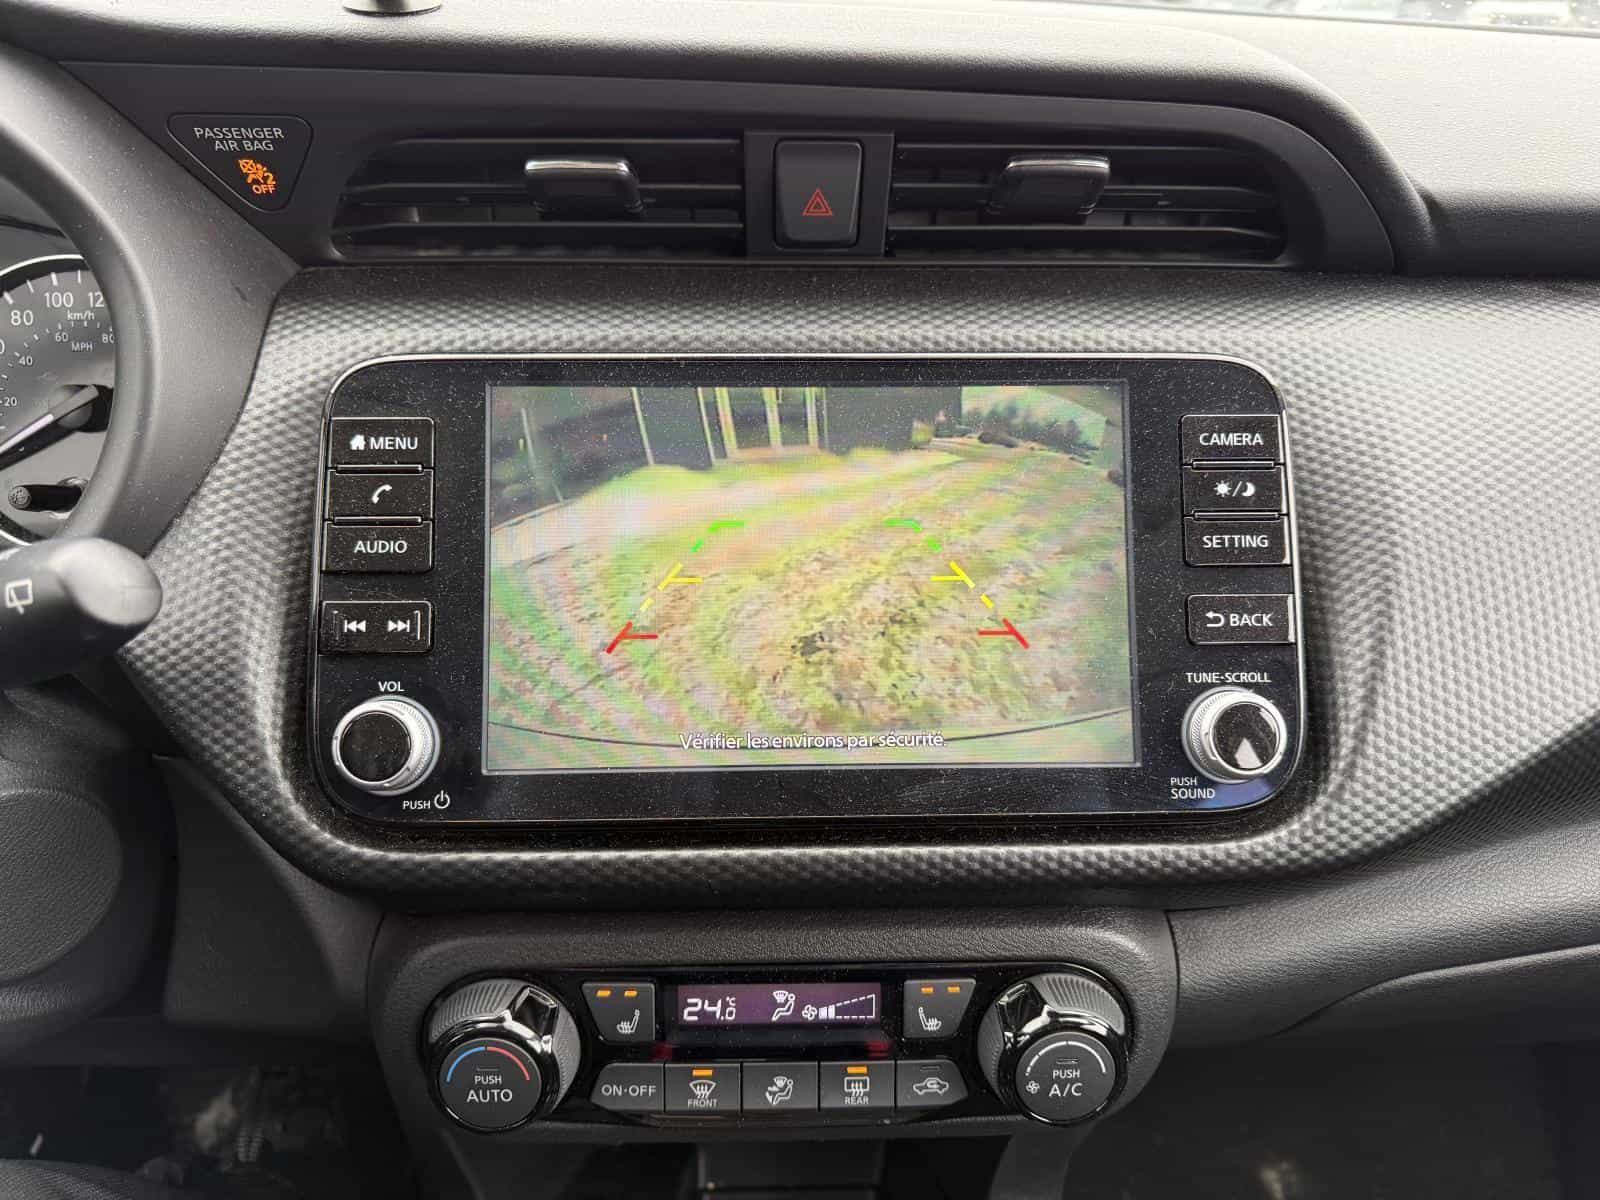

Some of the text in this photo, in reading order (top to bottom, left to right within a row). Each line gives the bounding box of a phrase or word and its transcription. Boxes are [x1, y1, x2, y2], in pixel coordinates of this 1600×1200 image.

[193, 127, 284, 139] PASSENGER
[215, 140, 274, 151] AIR BAG
[252, 184, 276, 194] OFF
[44, 291, 73, 308] 100
[10, 310, 33, 326] 80
[67, 310, 95, 321] km/h
[55, 332, 68, 342] 60
[72, 342, 93, 352] MPH
[19, 356, 33, 366] 40
[4, 396, 17, 407] 20
[369, 436, 418, 450] MENU
[1199, 433, 1264, 446] CAMERA
[354, 540, 408, 554] AUDIO
[1202, 535, 1269, 548] SETTING
[1229, 613, 1273, 627] BACK
[378, 681, 404, 692] VOL
[680, 731, 743, 750] Vérifier
[747, 732, 769, 748] les
[772, 732, 843, 748] environs
[847, 735, 875, 751] par
[1170, 777, 1198, 786] PUSH
[1171, 788, 1216, 799] SOUND
[402, 800, 431, 810] PUSH
[683, 998, 736, 1021] 24.0
[474, 1074, 502, 1085] PUSH
[1052, 1069, 1080, 1079] PUSH
[1048, 1082, 1082, 1097] A/C
[466, 1088, 513, 1103] AUTO
[844, 1096, 869, 1105] REAR
[687, 1098, 718, 1109] FRONT
